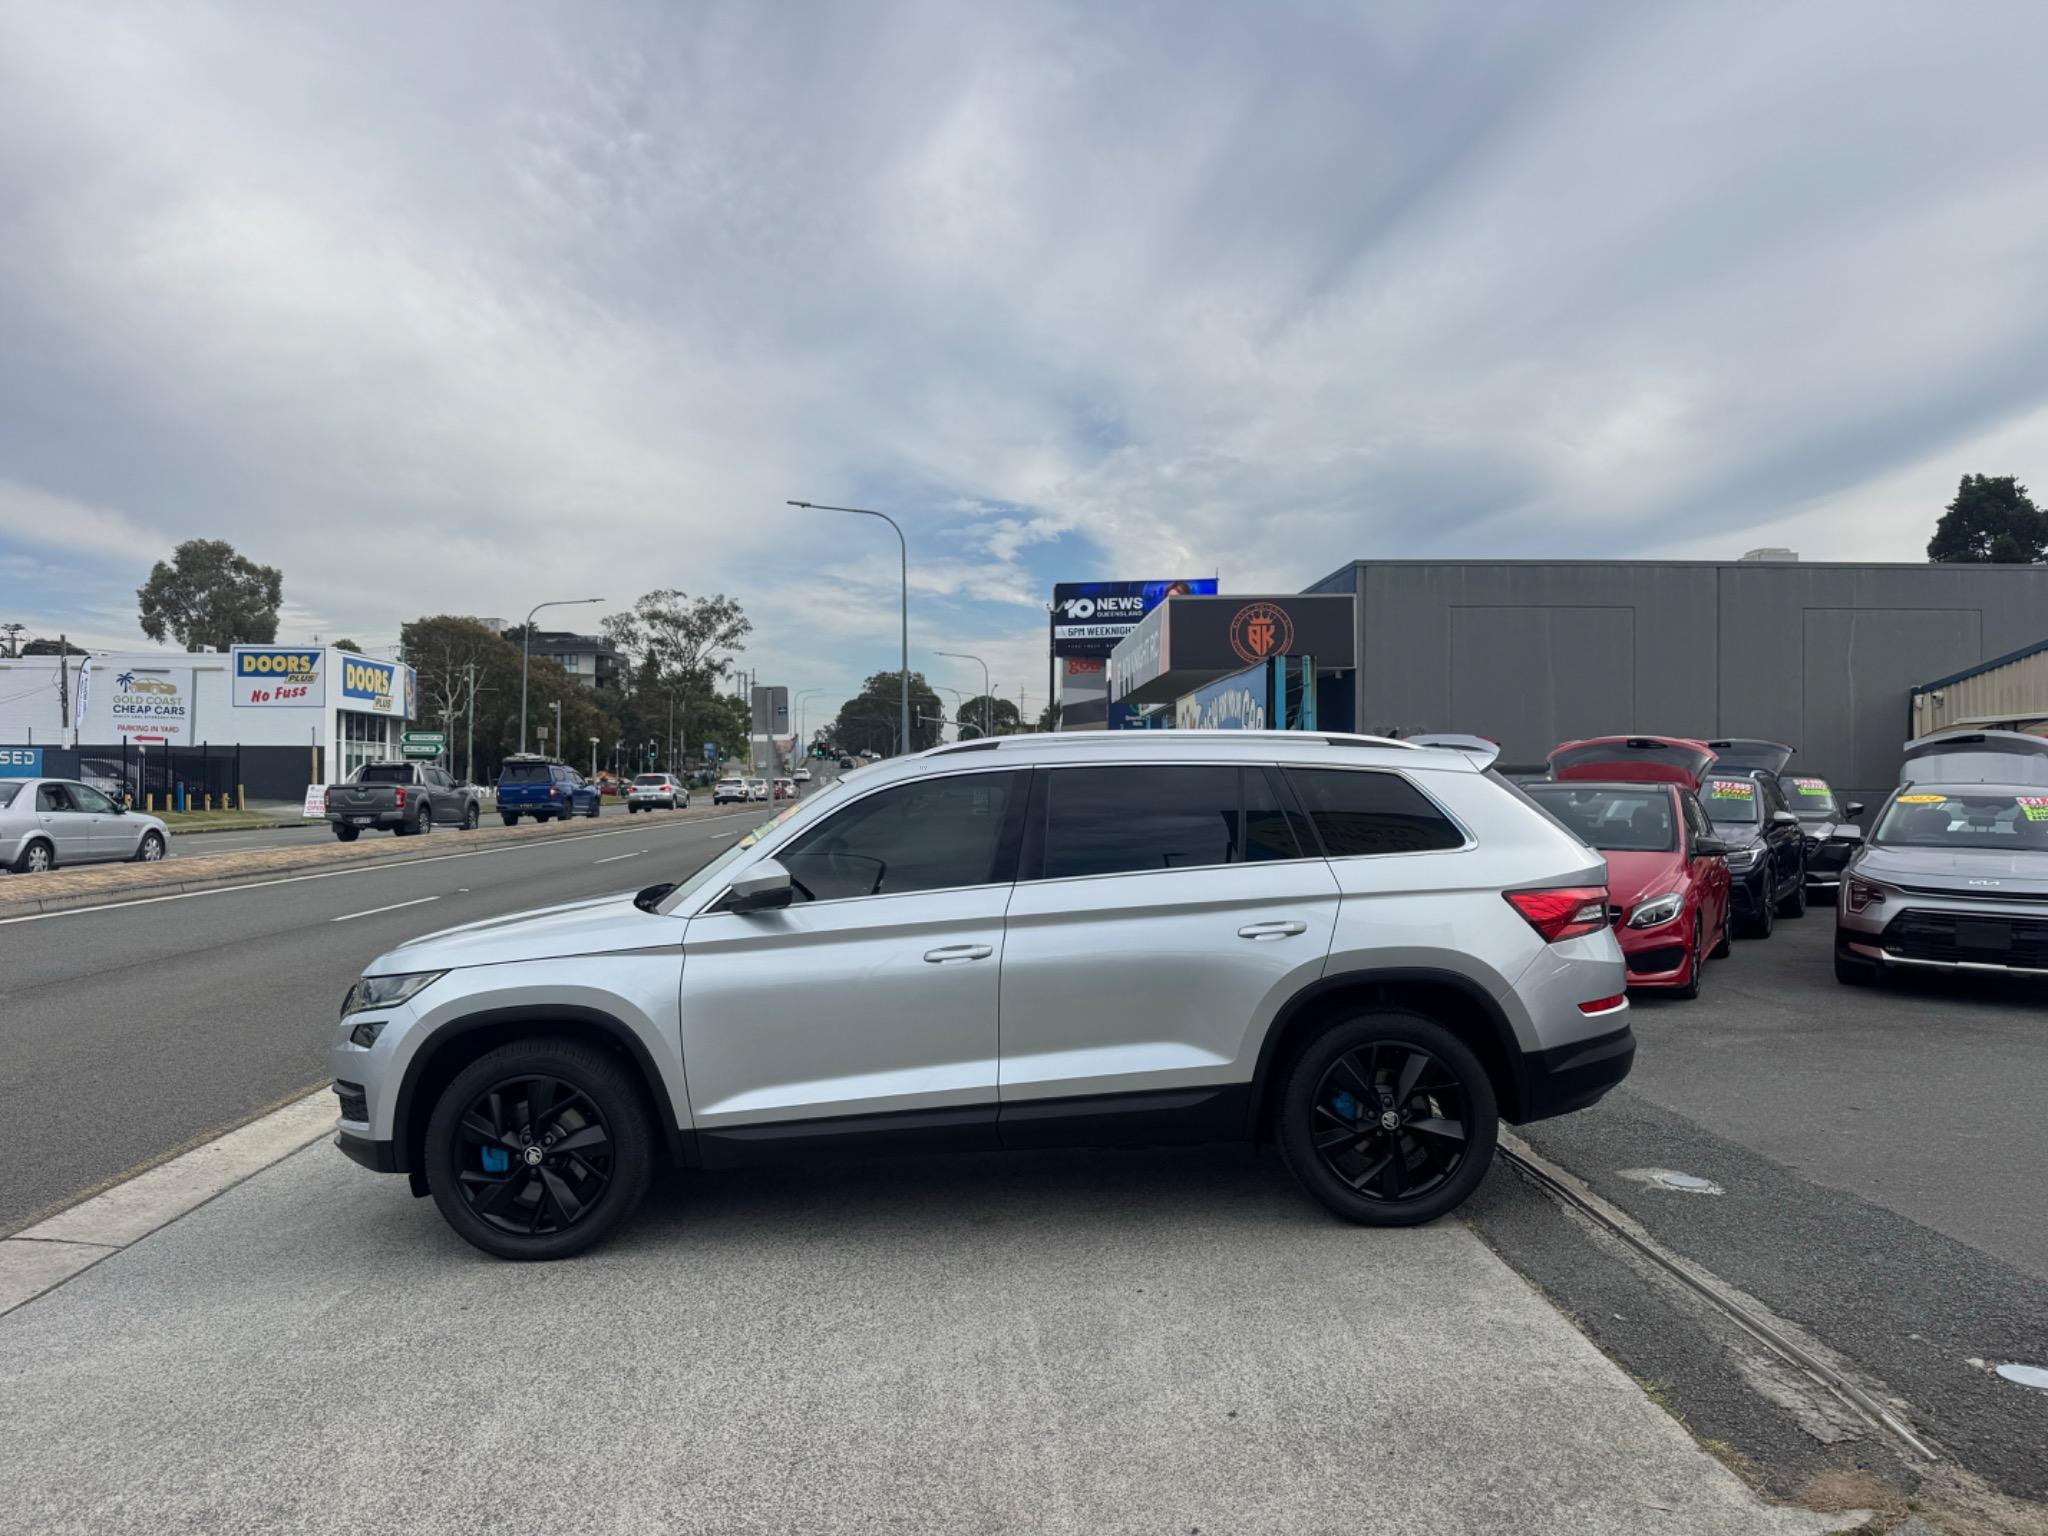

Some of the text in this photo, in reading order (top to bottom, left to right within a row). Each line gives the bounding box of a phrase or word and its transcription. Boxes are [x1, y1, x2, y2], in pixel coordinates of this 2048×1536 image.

[1097, 597, 1144, 610] NEWS
[1097, 610, 1143, 618] QUEENSLAND
[243, 655, 312, 673] DOORS
[288, 674, 315, 682] PLUS
[346, 663, 390, 694] DOORS
[113, 695, 183, 706] GOLD COAST
[251, 689, 270, 703] No
[375, 697, 392, 709] PLUS
[113, 704, 186, 715] CHEAP CARS
[117, 724, 149, 733] PARKING
